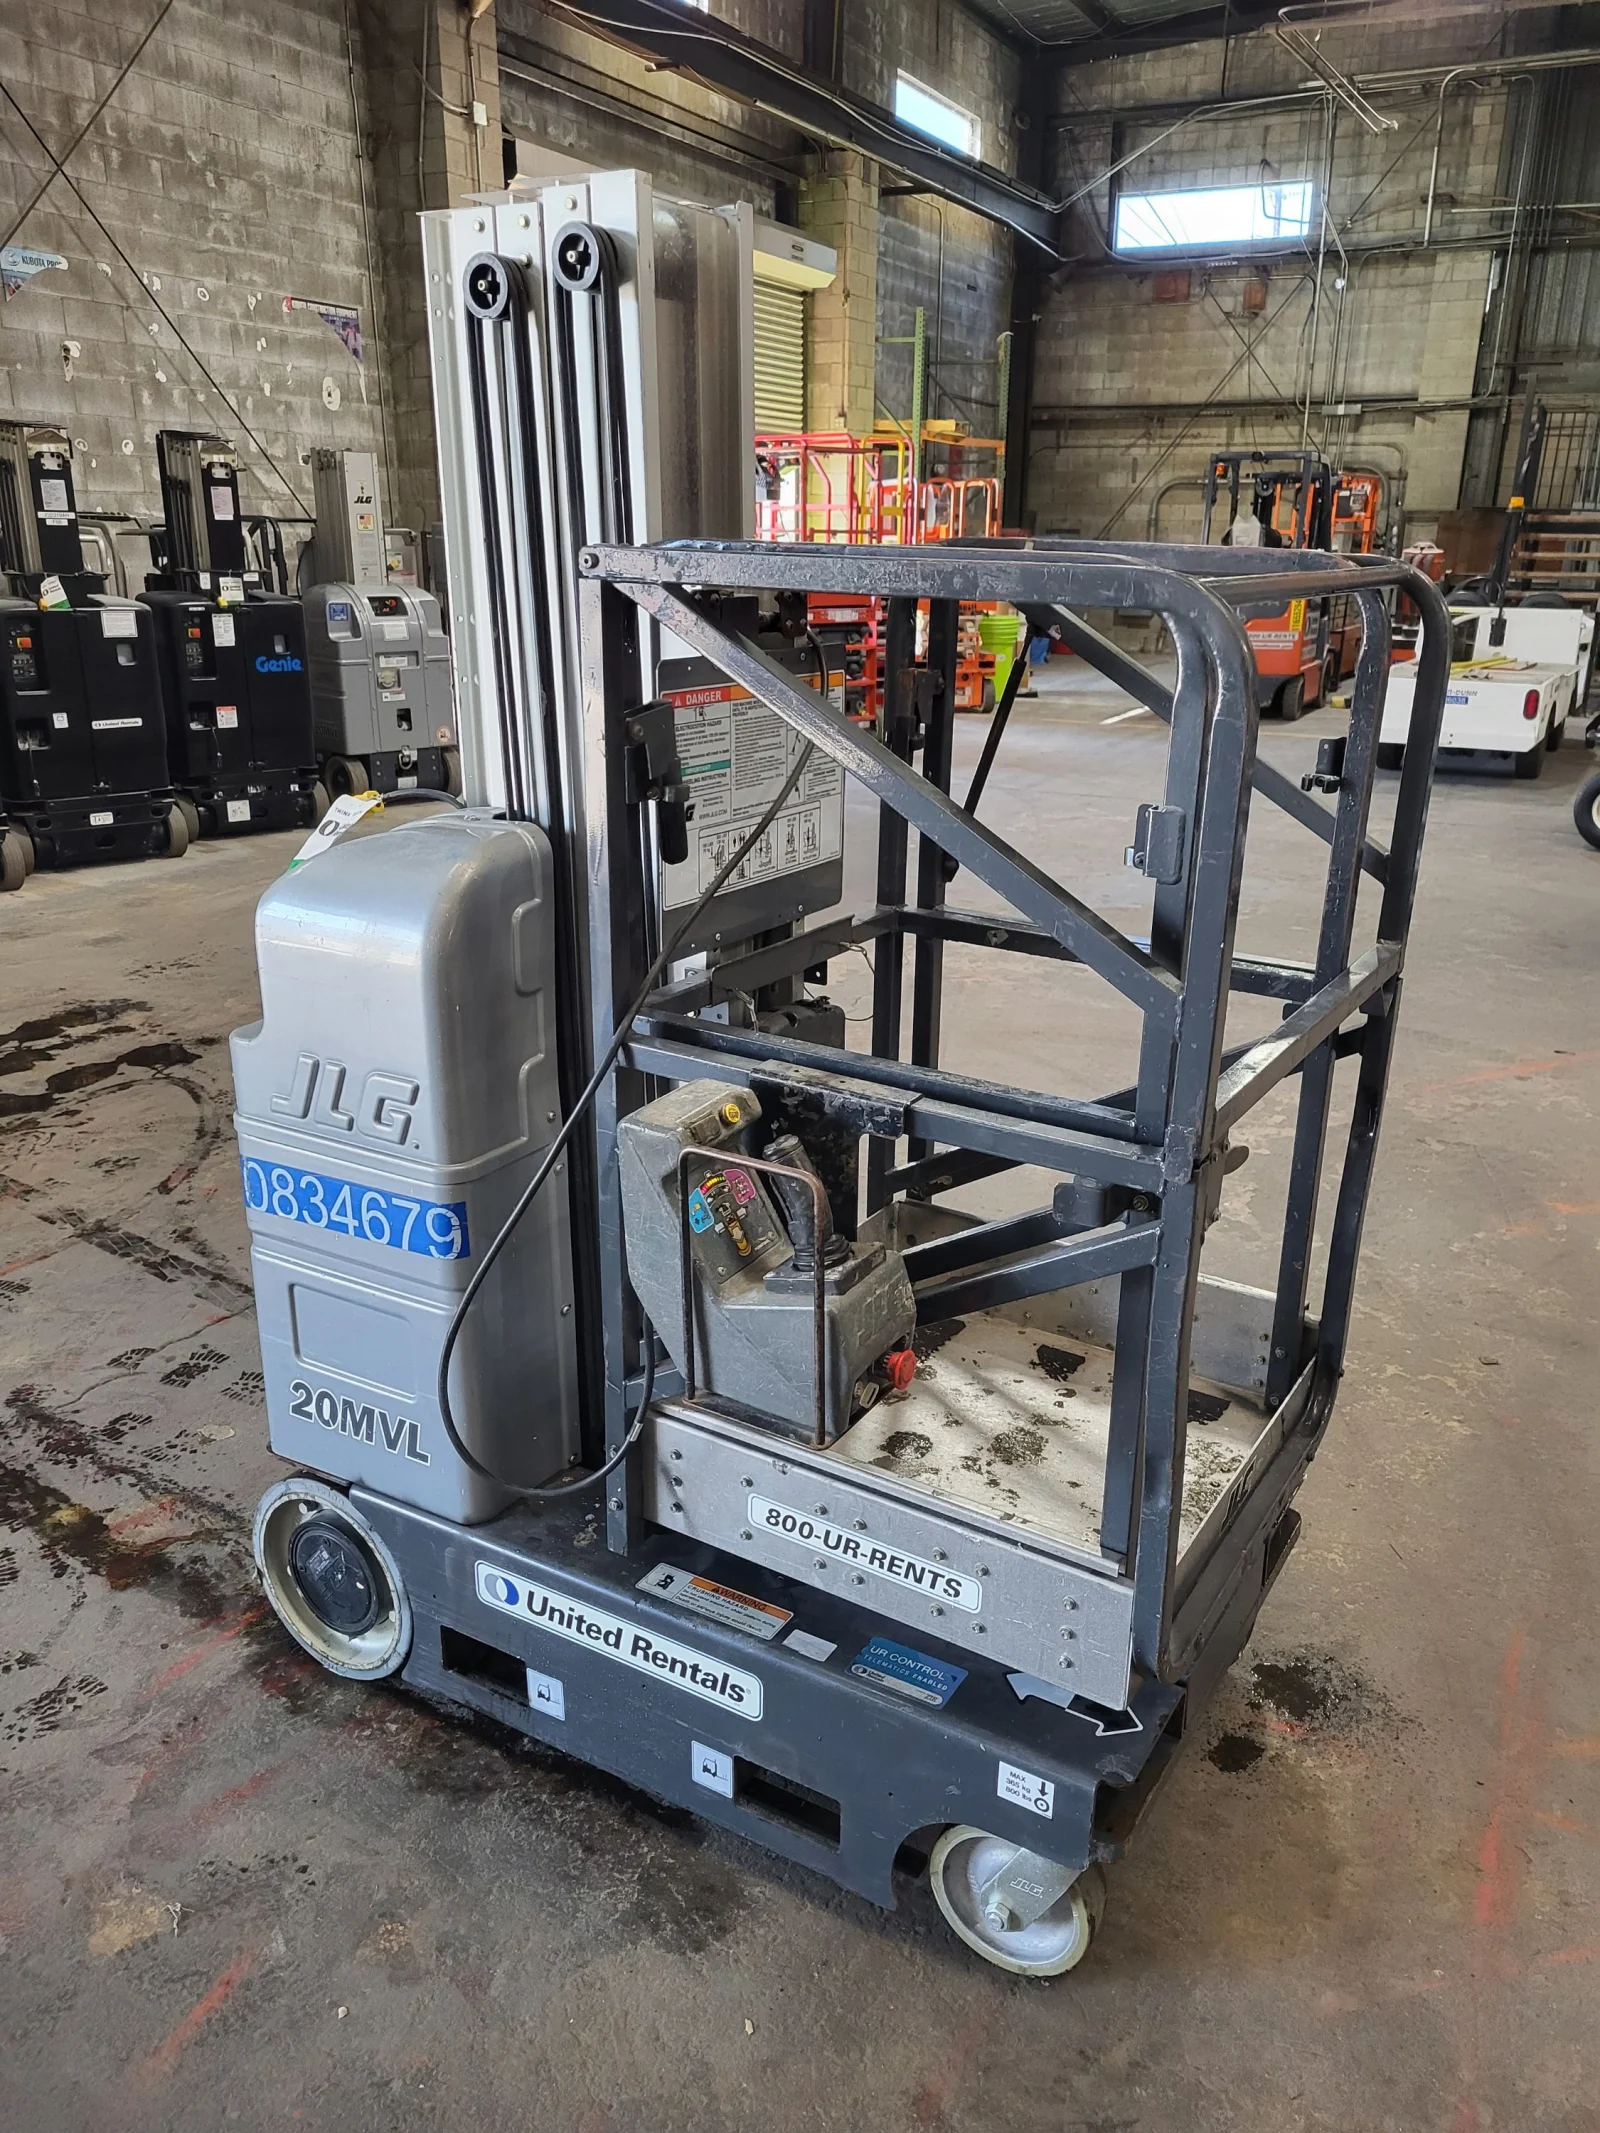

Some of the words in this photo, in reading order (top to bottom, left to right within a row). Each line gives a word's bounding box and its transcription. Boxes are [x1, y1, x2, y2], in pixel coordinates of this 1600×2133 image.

[21, 255, 46, 268] KUBOTA
[353, 495, 373, 504] JLG
[254, 655, 302, 673] Genie
[685, 690, 722, 706] DANGER
[269, 1051, 420, 1147] JLG
[289, 1379, 431, 1467] 20MVL
[764, 1507, 963, 1599] 800-UR-RENTS
[675, 1595, 690, 1604] Death
[687, 1585, 721, 1601] CRUSHING
[721, 1597, 749, 1612] HAZARD
[717, 1587, 767, 1612] WARNING
[526, 1590, 624, 1651] United
[630, 1633, 746, 1703] Rentals
[863, 1654, 911, 1676] TELEMATICS
[912, 1673, 949, 1691] ENABLED
[870, 1645, 889, 1658] UR
[889, 1652, 945, 1681] CONTROL
[1005, 1777, 1020, 1789] 365
[1021, 1784, 1031, 1794] kg
[1009, 1771, 1027, 1783] MAX
[1005, 1786, 1020, 1797] 800
[1021, 1793, 1032, 1802] lbs
[1009, 1877, 1045, 1897] JLG
